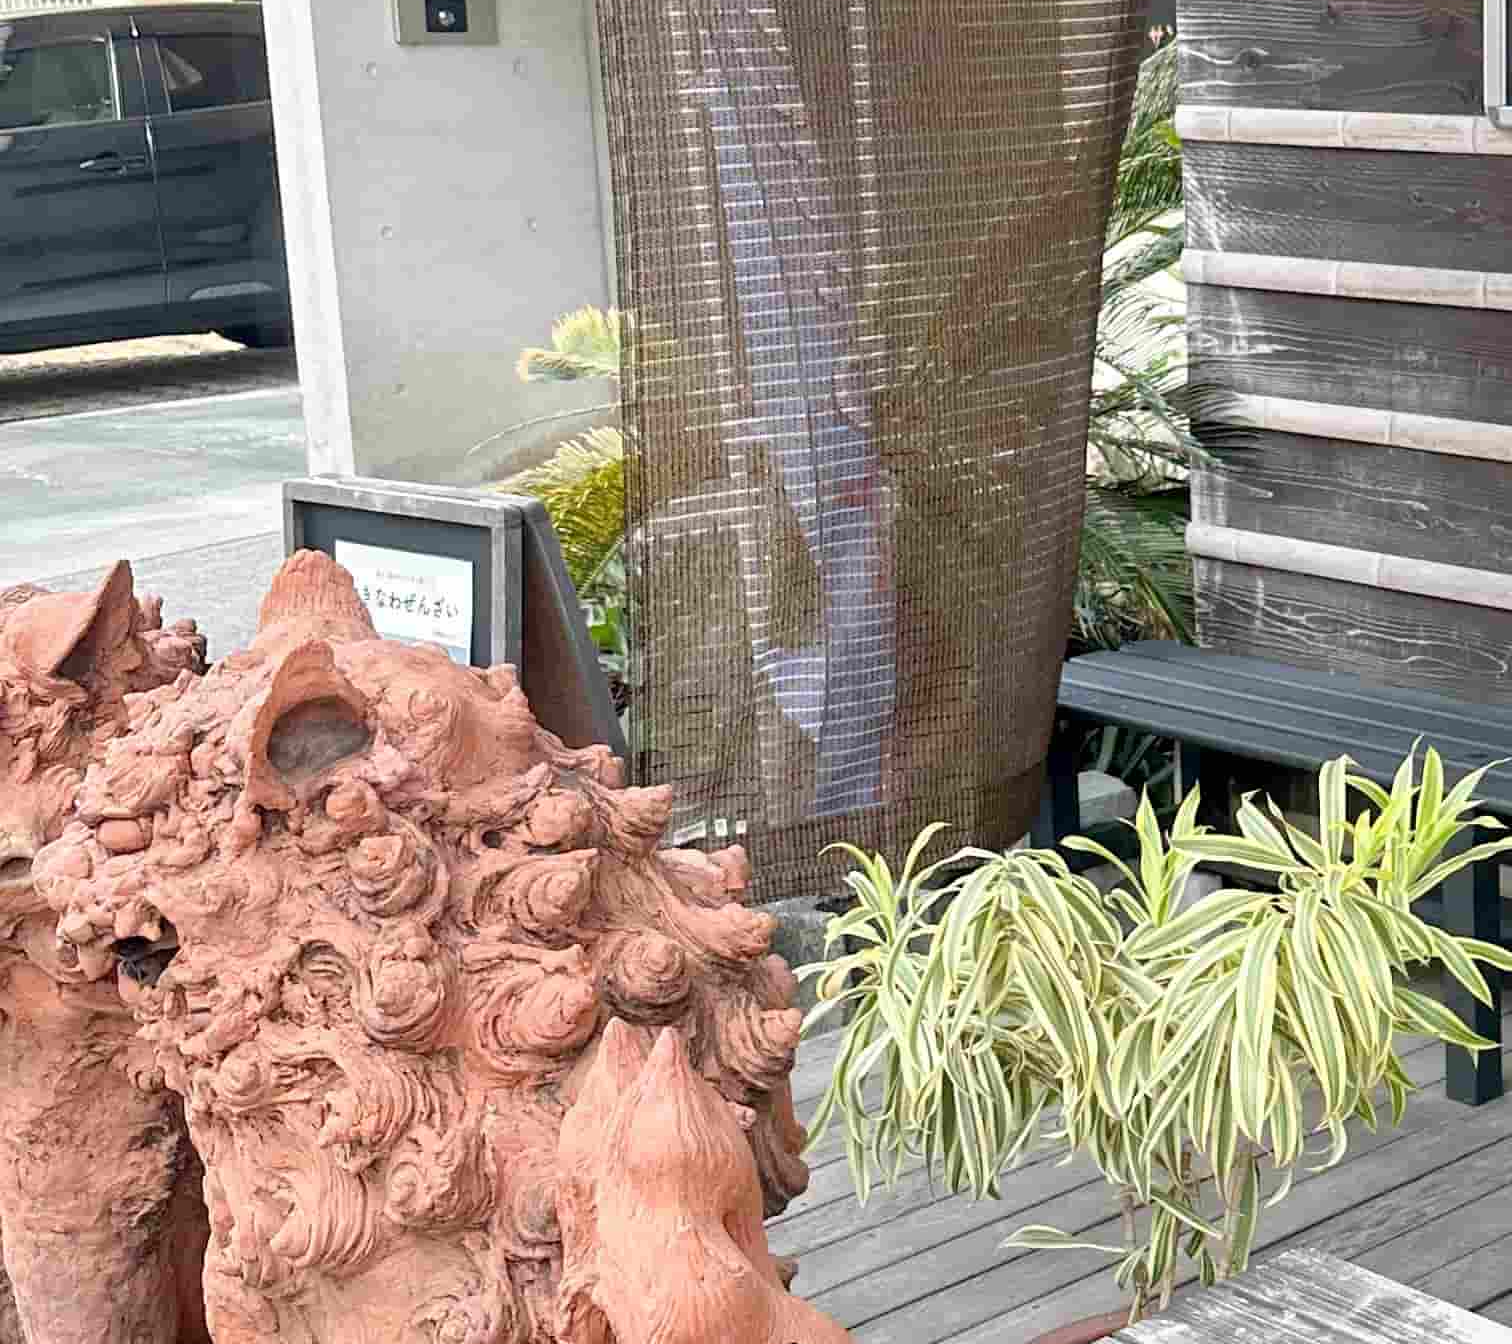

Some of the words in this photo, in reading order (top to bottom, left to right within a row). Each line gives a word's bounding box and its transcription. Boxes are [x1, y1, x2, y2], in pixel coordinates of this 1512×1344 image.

[360, 583, 459, 618] きなわぜんざい
